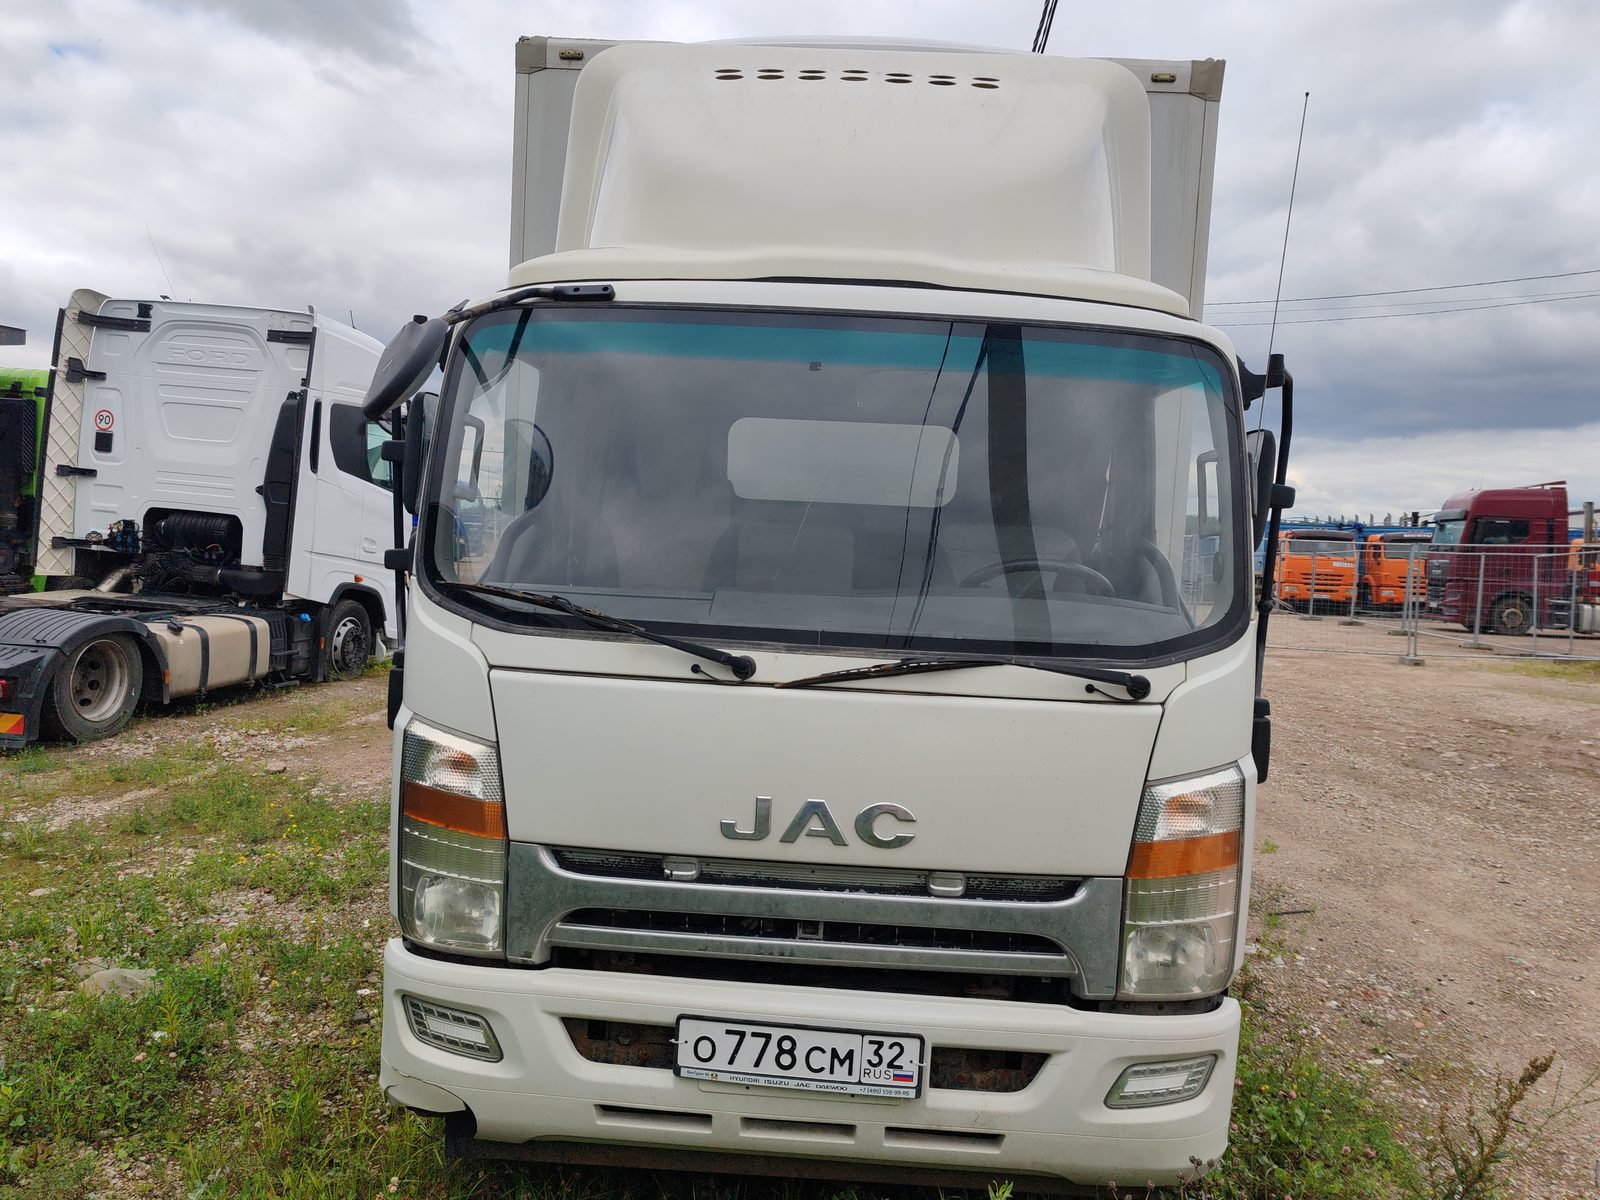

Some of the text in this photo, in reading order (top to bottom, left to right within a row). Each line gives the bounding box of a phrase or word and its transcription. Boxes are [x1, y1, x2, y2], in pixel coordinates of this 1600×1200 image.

[168, 347, 250, 365] FORD
[98, 414, 111, 425] 90
[720, 795, 917, 849] JAC
[867, 1040, 904, 1069] 32
[729, 1075, 760, 1083] HYUNDAI
[863, 1068, 891, 1080] RUS
